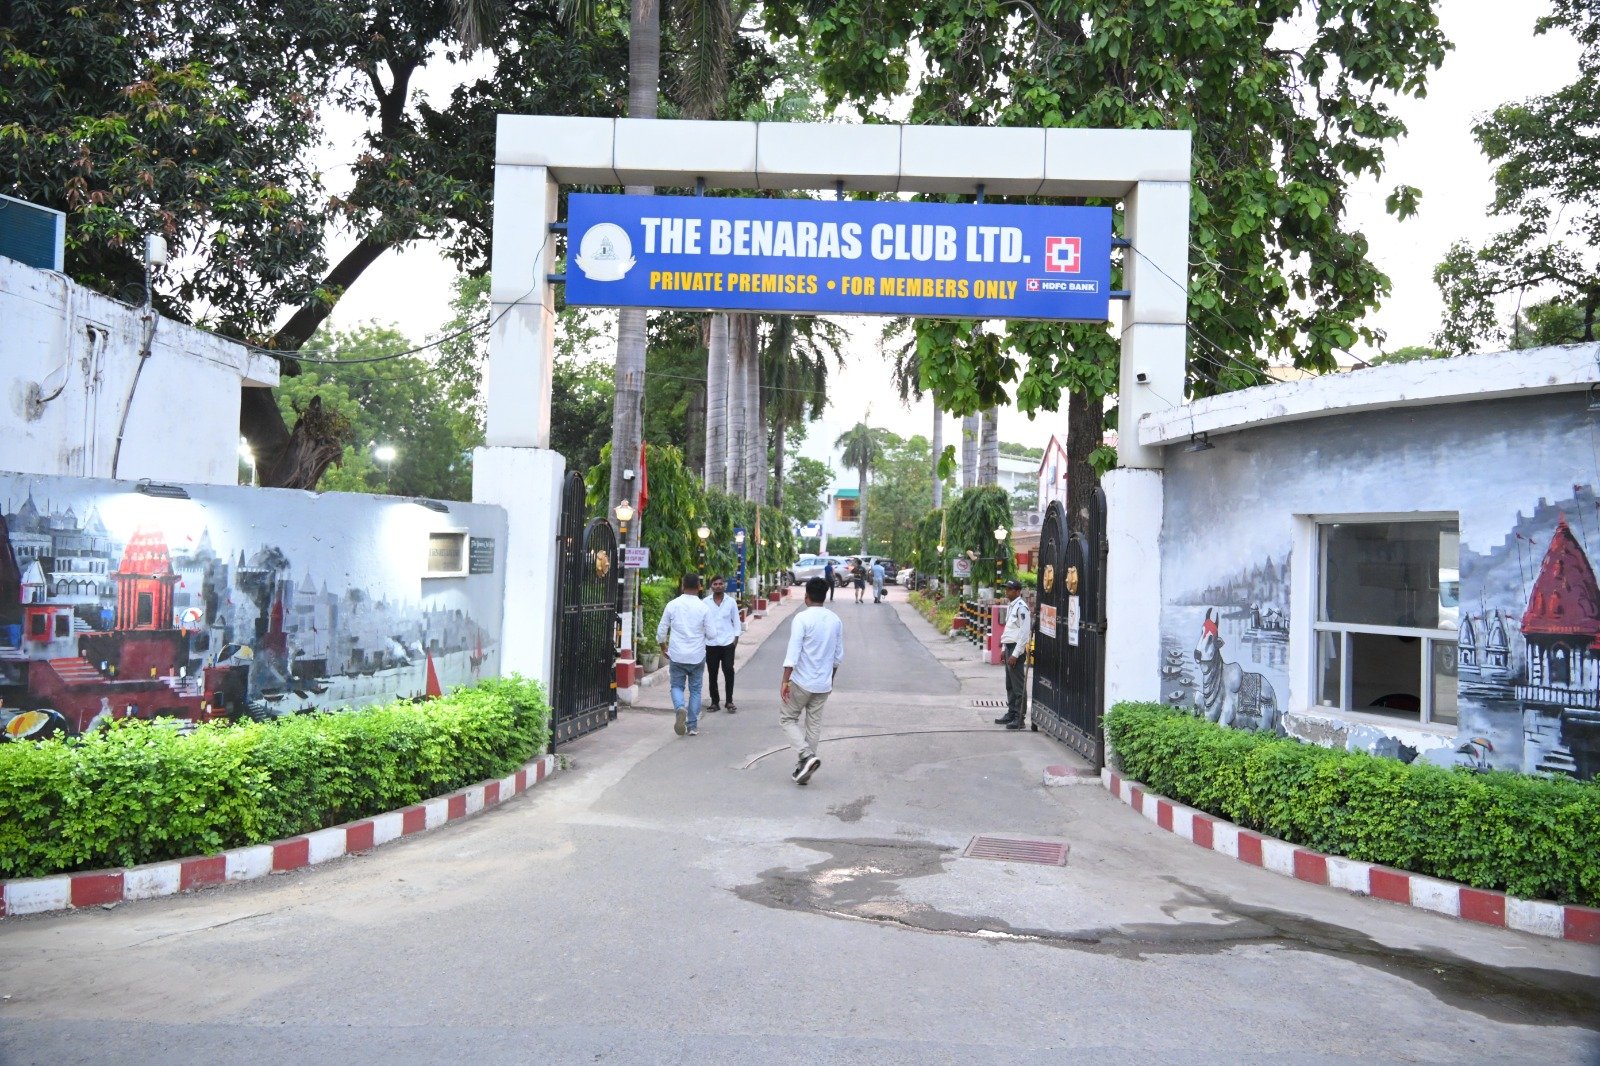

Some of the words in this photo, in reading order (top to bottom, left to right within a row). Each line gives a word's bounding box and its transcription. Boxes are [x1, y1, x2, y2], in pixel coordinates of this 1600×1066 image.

[640, 217, 702, 255] THE
[709, 219, 863, 260] BENARAS
[870, 223, 957, 262] CLUB
[966, 225, 1031, 264] LTD.
[649, 271, 723, 291] PRIVATE
[728, 274, 818, 293] PREMISES
[842, 277, 875, 295] FOR
[880, 278, 969, 298] MEMBERS
[974, 281, 1018, 299] ONLY
[1042, 282, 1067, 290] HDFC
[1069, 283, 1095, 291] BANK
